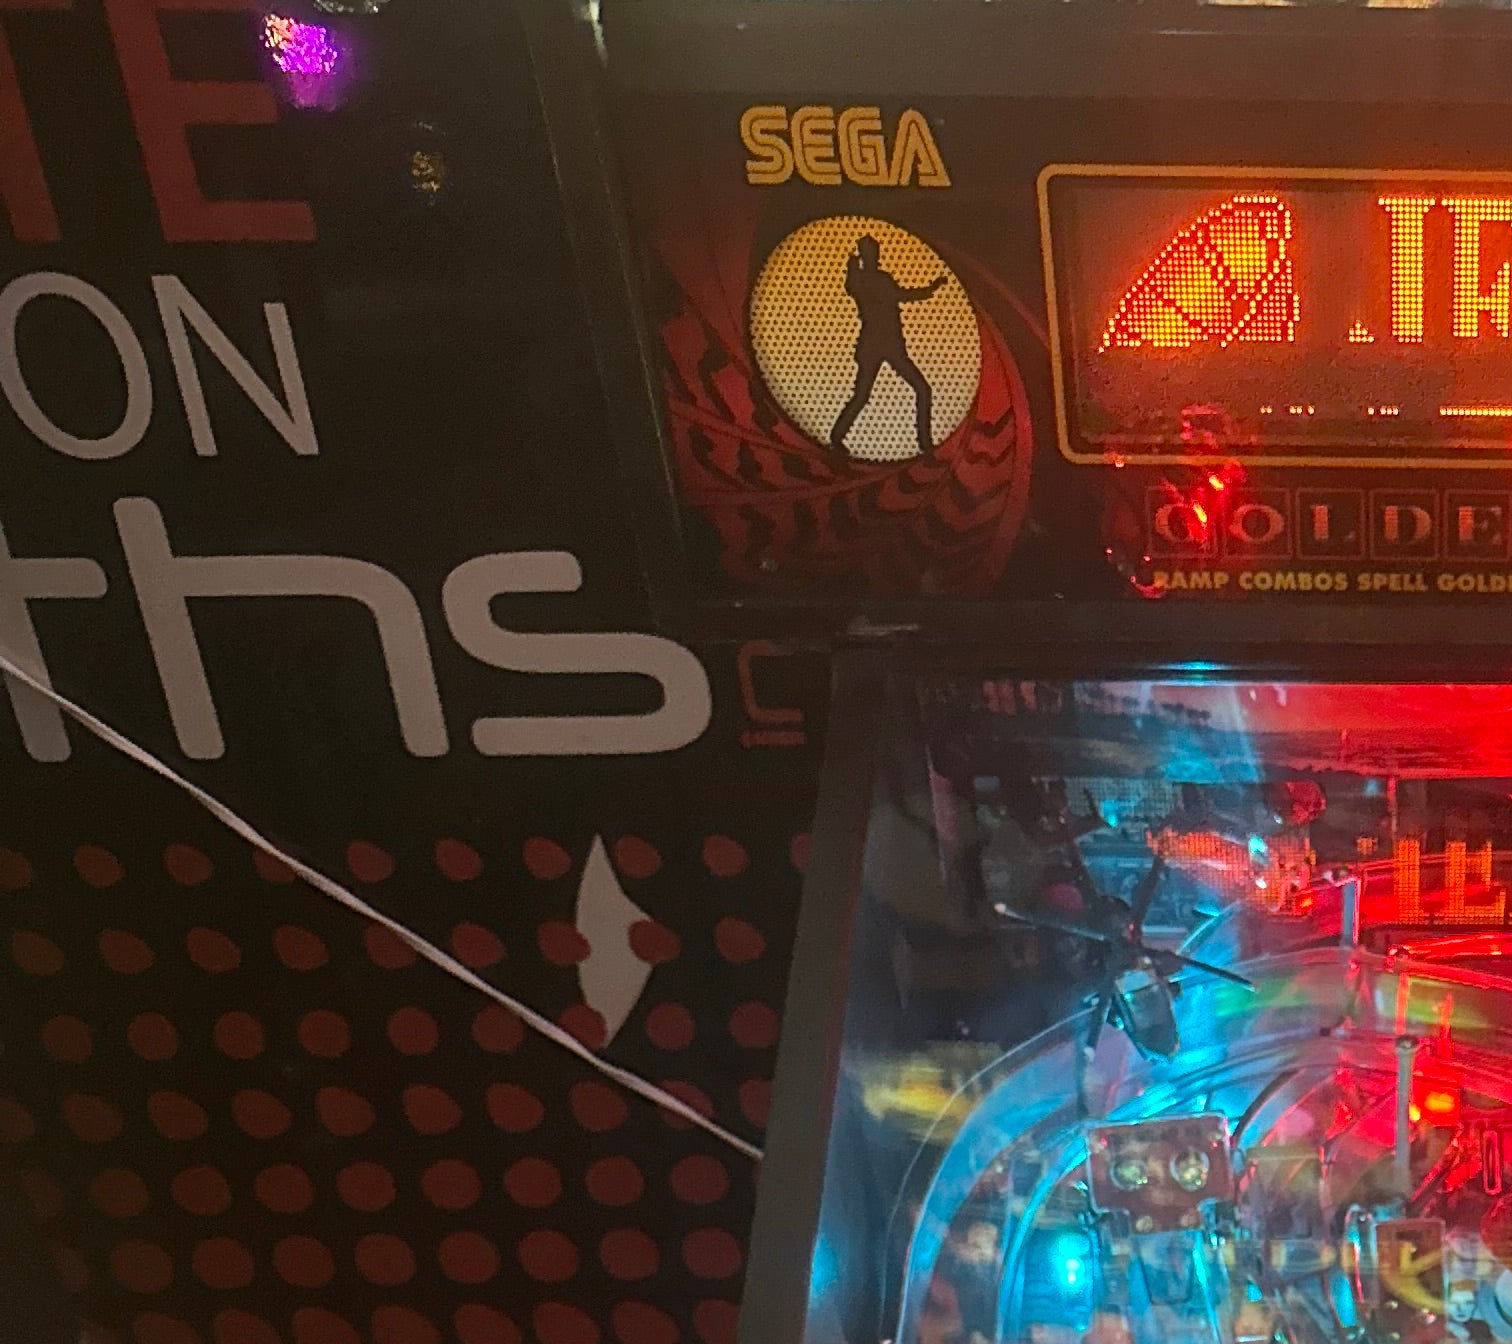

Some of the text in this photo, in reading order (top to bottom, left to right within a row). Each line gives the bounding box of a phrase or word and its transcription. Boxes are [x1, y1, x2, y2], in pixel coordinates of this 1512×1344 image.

[740, 106, 952, 188] SEGA
[1153, 571, 1229, 590] RAMP
[1239, 571, 1348, 592] COMBOS
[1357, 573, 1428, 593] SPELL
